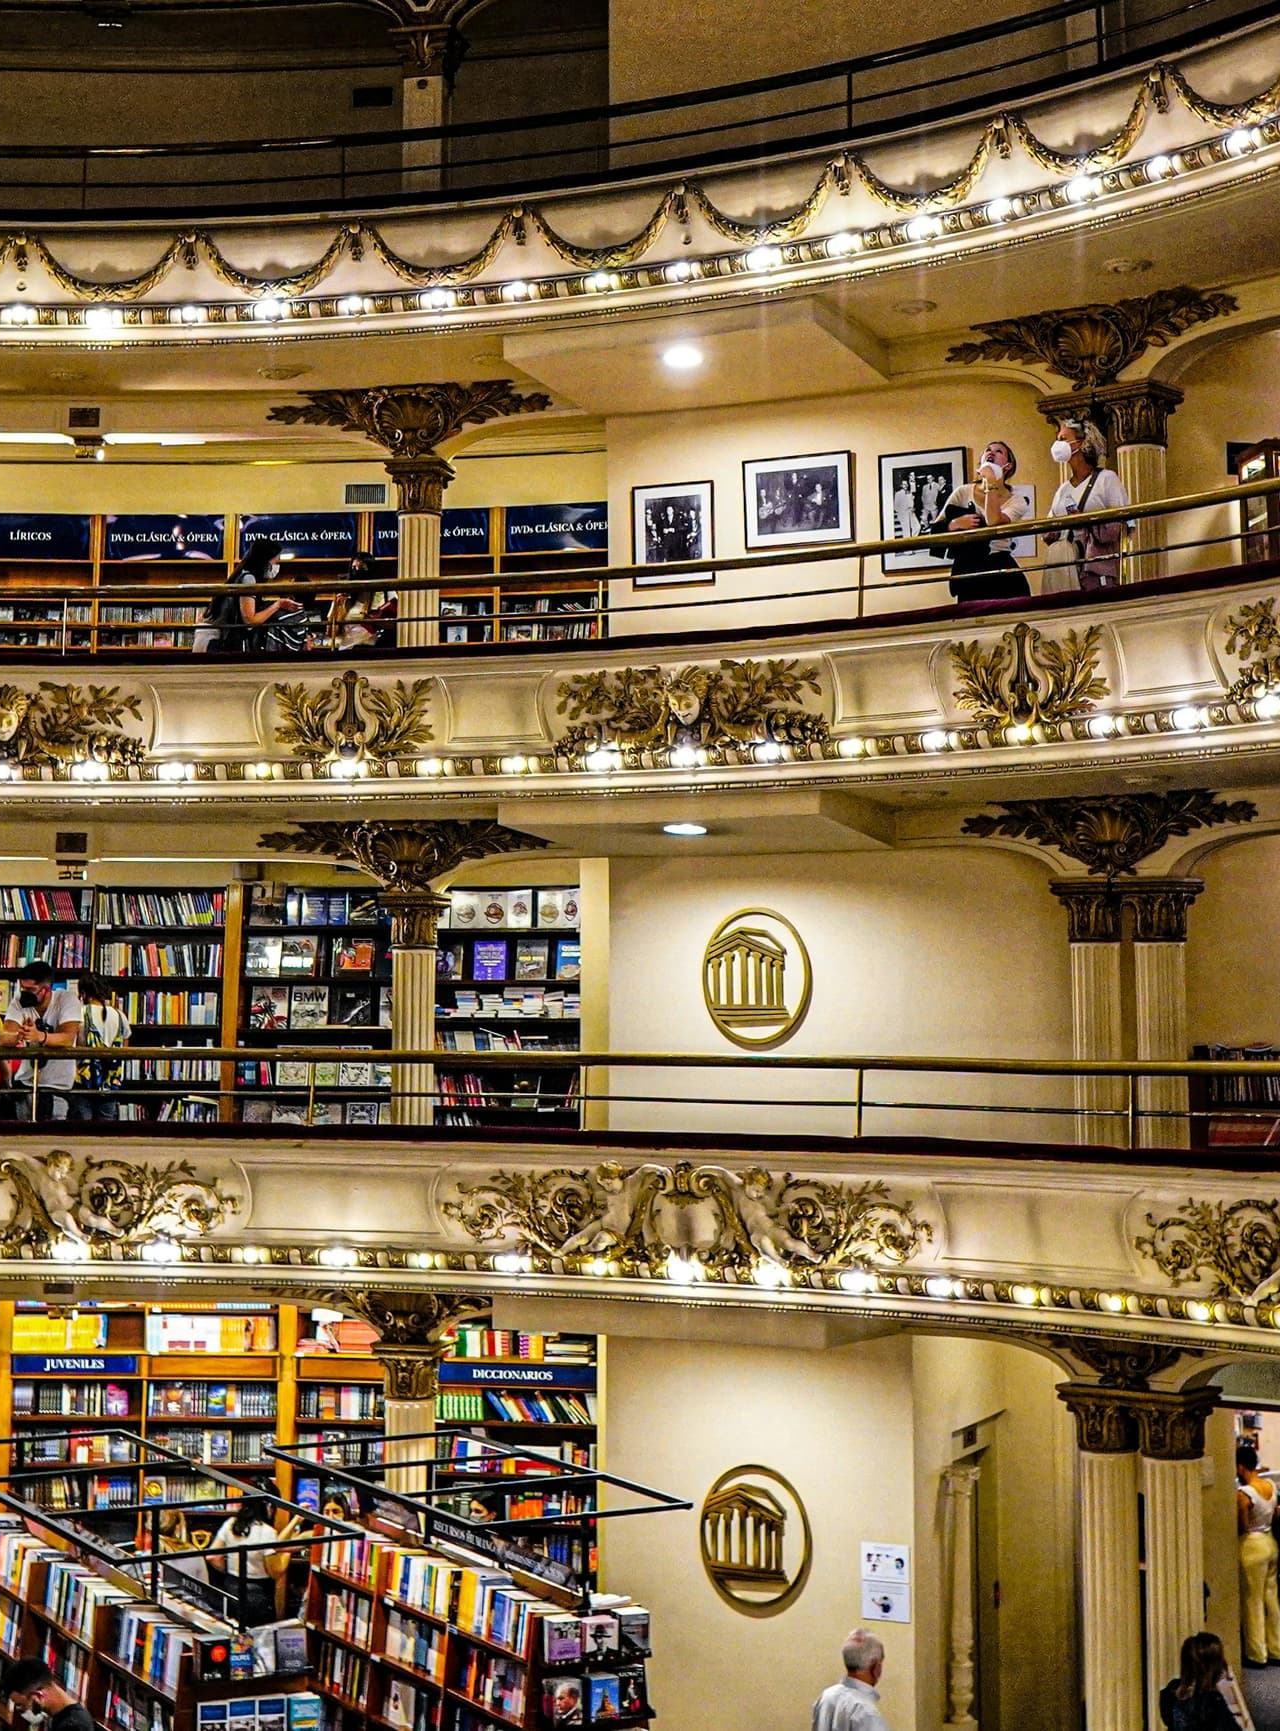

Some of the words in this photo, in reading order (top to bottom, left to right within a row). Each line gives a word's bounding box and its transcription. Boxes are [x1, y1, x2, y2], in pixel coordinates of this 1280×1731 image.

[378, 530, 399, 539] DVD
[443, 528, 451, 537] &
[452, 526, 485, 537] ÓPERA
[510, 525, 534, 535] DVDs
[535, 522, 575, 533] CLÁSICA
[575, 523, 583, 531] &
[585, 520, 608, 531] ÓPE
[9, 528, 52, 542] LÍRICOS
[111, 533, 134, 542] DVDs
[136, 531, 176, 543] CLÁSICA
[177, 534, 185, 542] &
[186, 531, 219, 543] ÓPERA
[269, 530, 309, 541] CLÁSICA
[310, 532, 319, 541] &
[320, 529, 352, 541] ÓPERA
[293, 992, 327, 1003] BMW
[44, 1358, 105, 1371] JUVENILES
[472, 1368, 554, 1381] DICCIONARIOS
